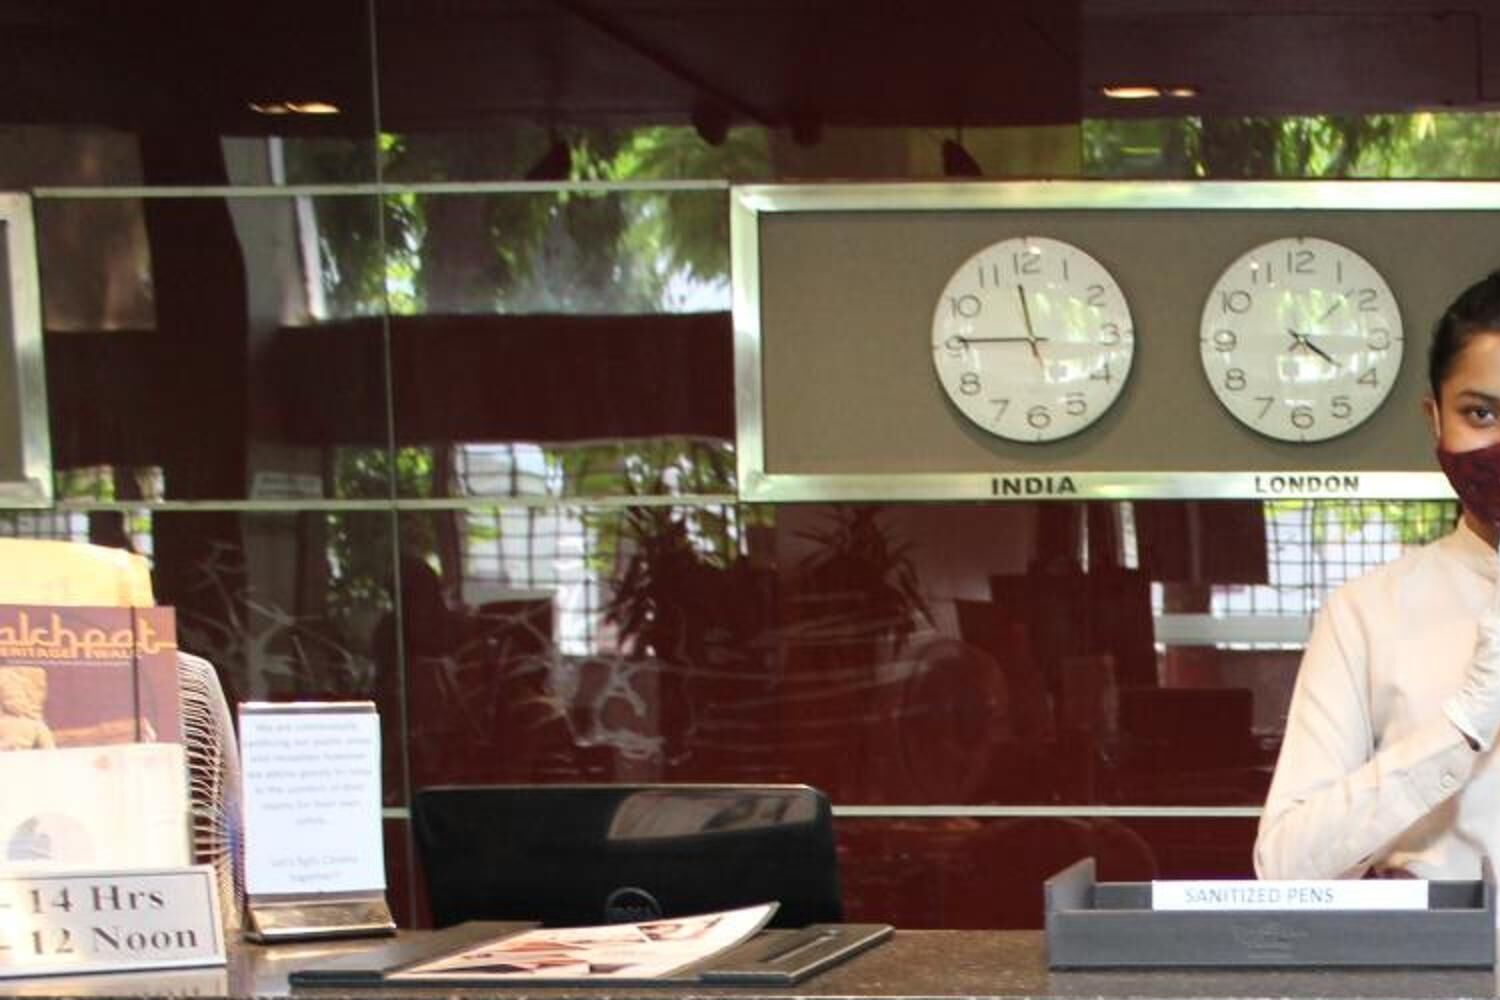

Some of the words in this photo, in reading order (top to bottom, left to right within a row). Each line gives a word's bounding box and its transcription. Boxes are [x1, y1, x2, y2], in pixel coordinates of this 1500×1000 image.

[1012, 251, 1041, 275] 12
[1062, 257, 1069, 281] 1
[1251, 260, 1272, 284] 11
[1287, 250, 1316, 274] 12
[1336, 259, 1343, 284] 1
[978, 263, 1000, 289] 11
[950, 294, 982, 319] 10
[1086, 284, 1106, 307] 2
[1222, 290, 1252, 314] 10
[1358, 287, 1378, 312] 2
[944, 334, 970, 358] 9
[1101, 322, 1121, 347] 3
[1213, 328, 1238, 353] 9
[1366, 327, 1391, 351] 3
[959, 371, 982, 396] 8
[1089, 360, 1112, 384] 4
[1224, 367, 1247, 392] 8
[1356, 367, 1379, 388] 4
[990, 399, 1010, 422] 7
[1065, 391, 1088, 416] 5
[1254, 396, 1275, 421] 7
[1330, 395, 1353, 419] 5
[1026, 404, 1051, 429] 6
[1289, 405, 1315, 430] 6
[991, 475, 1078, 496] INDIA
[1254, 475, 1360, 494] LONDON
[91, 884, 166, 911] Hrs
[1185, 886, 1281, 904] SANITIZED
[1287, 886, 1335, 903] PENS
[31, 927, 75, 955] 12
[91, 925, 199, 953] Noon
